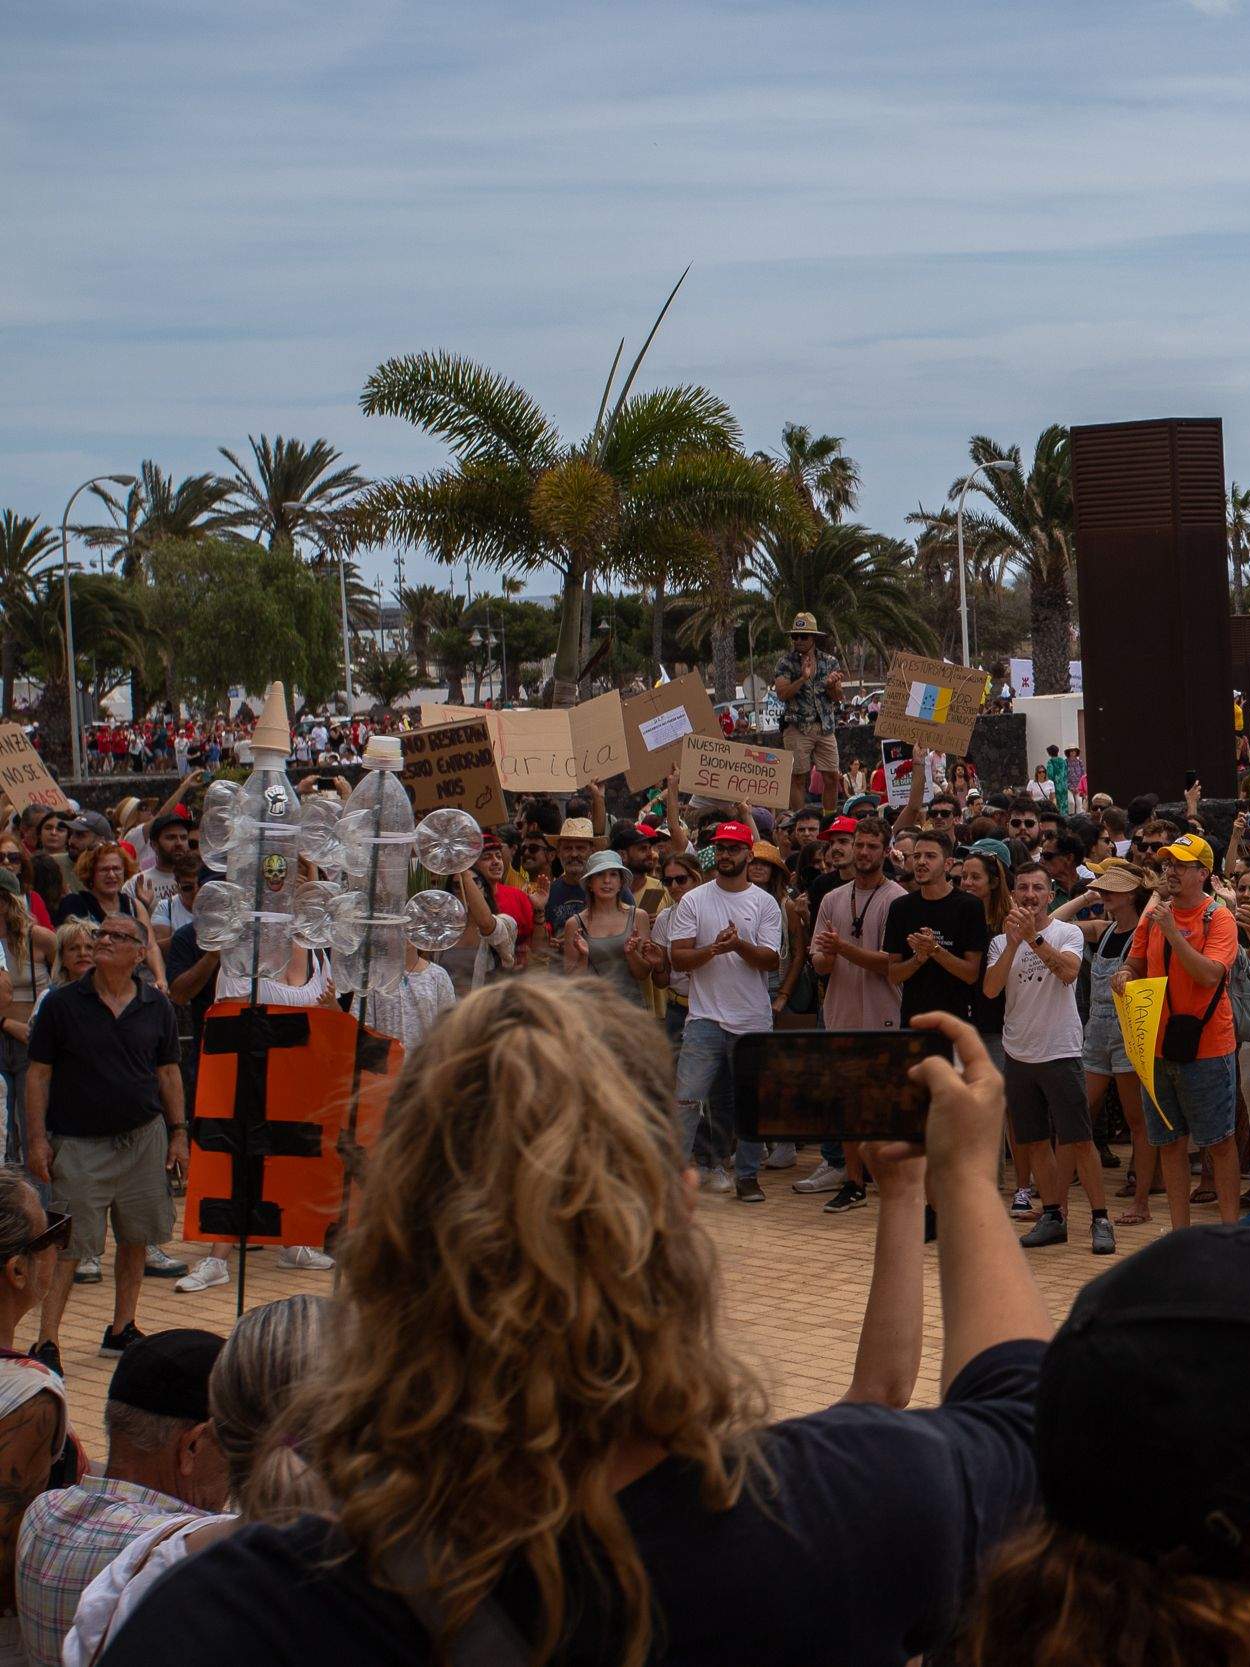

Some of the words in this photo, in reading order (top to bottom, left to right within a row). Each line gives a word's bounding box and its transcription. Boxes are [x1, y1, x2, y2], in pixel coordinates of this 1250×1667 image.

[687, 737, 732, 755] NUESTRA
[500, 743, 620, 778] aricia
[700, 753, 777, 778] BIODIVERSIDAD
[435, 778, 466, 801] NOS
[694, 769, 721, 789] SE
[727, 775, 780, 797] ACABA
